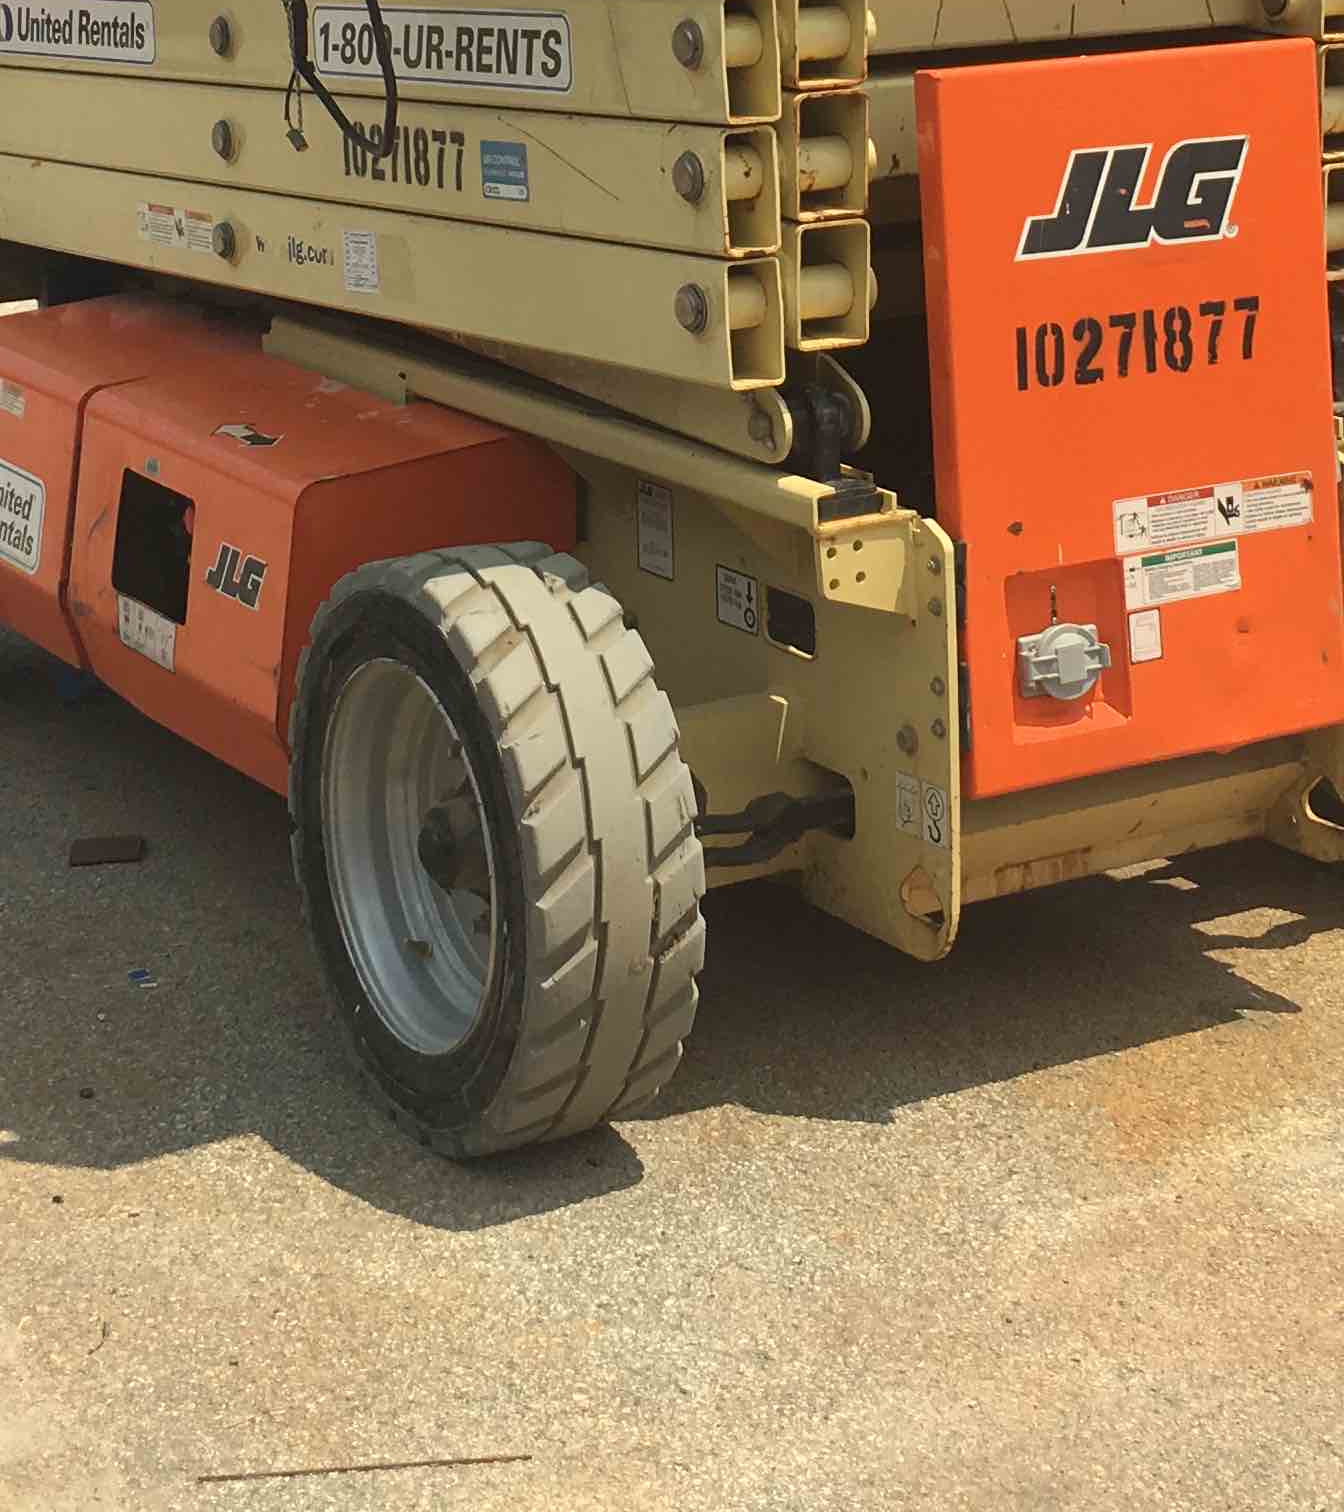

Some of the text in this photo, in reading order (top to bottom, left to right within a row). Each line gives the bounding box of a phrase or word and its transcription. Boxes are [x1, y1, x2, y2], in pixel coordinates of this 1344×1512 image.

[17, 6, 145, 50] United Rentals
[1013, 134, 1250, 262] JLG
[1015, 296, 1260, 391] 10271877
[205, 542, 268, 610] JLG
